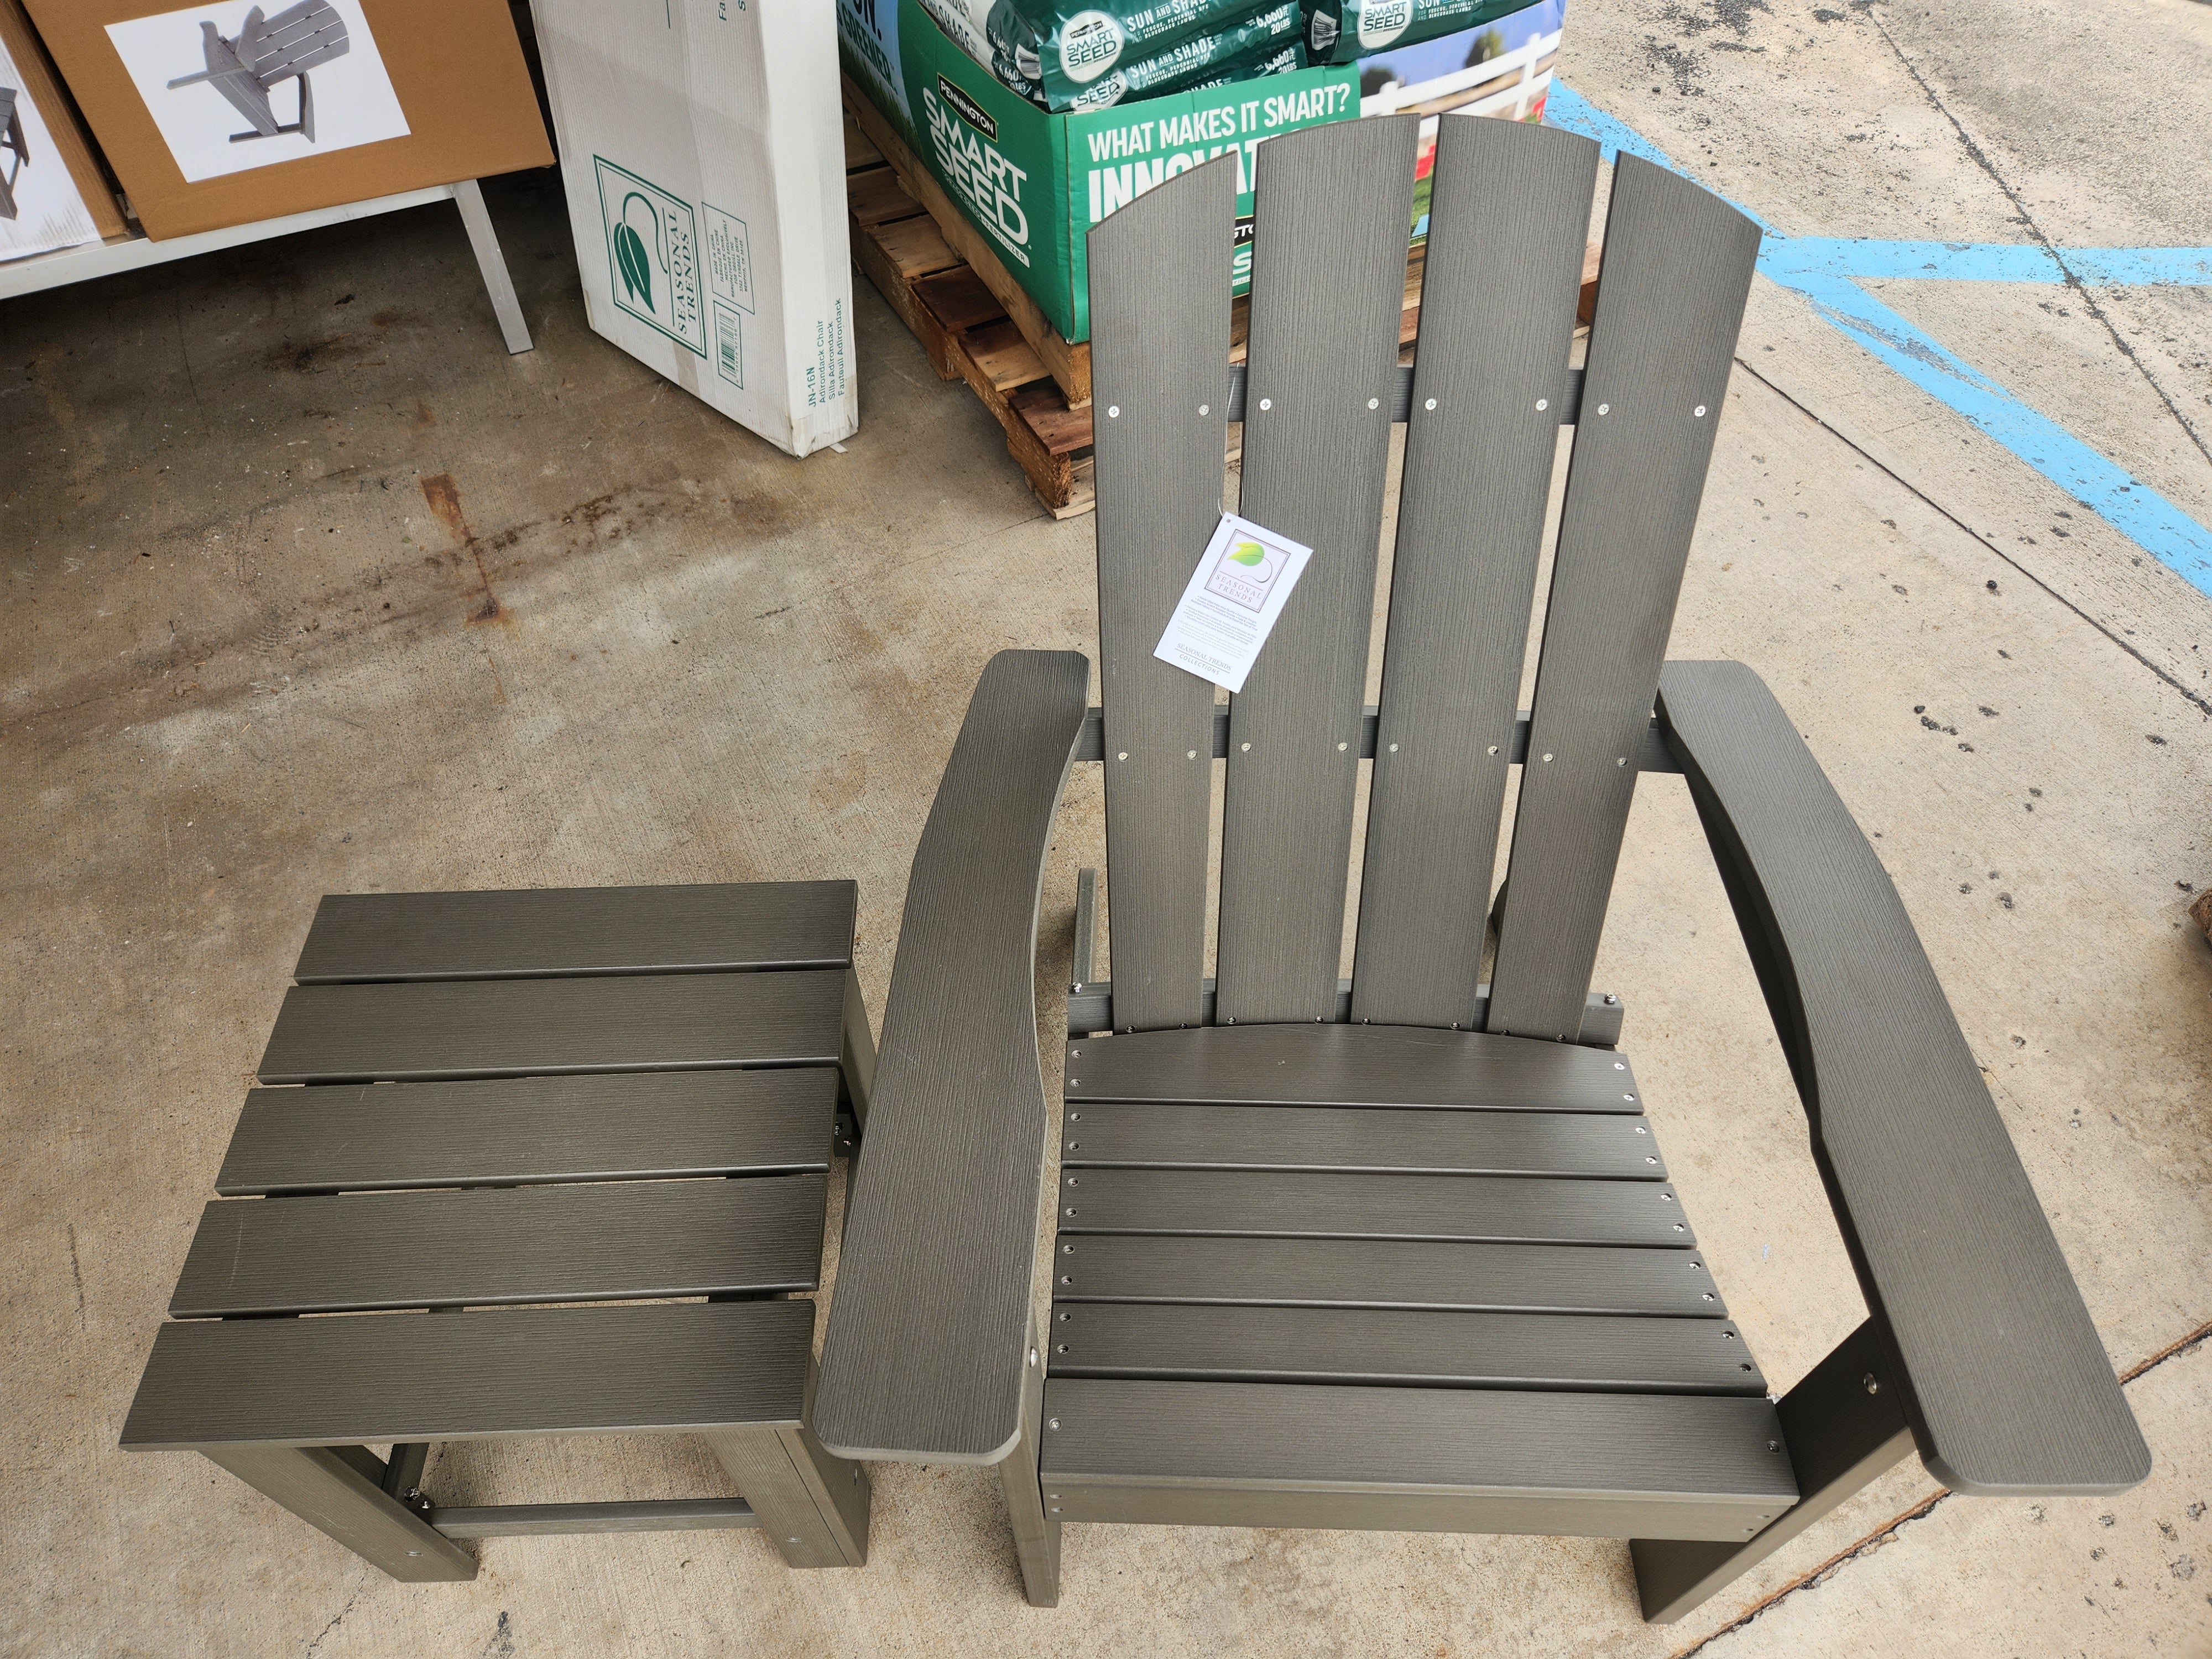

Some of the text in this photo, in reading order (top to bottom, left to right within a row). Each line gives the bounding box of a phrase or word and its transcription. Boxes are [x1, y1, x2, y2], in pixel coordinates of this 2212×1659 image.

[1127, 0, 1212, 32] SUN AND SHA
[1363, 13, 1405, 32] SEED
[1365, 2, 1406, 19] SMART
[1067, 28, 1114, 55] SMART
[1068, 40, 1117, 67] SEED
[1130, 59, 1157, 79] SUN
[1159, 53, 1173, 66] AND
[1173, 36, 1216, 62] SHADE
[941, 80, 994, 134] PENNINGTON
[1087, 82, 1350, 163] WHAT MAKES IT SMART?
[923, 87, 1027, 202] SMART
[930, 124, 1029, 245] SEED
[669, 210, 687, 334] SEASONAL
[681, 233, 696, 323] TRENDS
[806, 367, 816, 408] JN-16N
[1214, 574, 1263, 599] SEASONAL
[1217, 583, 1253, 603] TRENDS
[1176, 643, 1232, 671] SEASONAL TRENDS
[1178, 653, 1220, 675] COLLECTIONS
